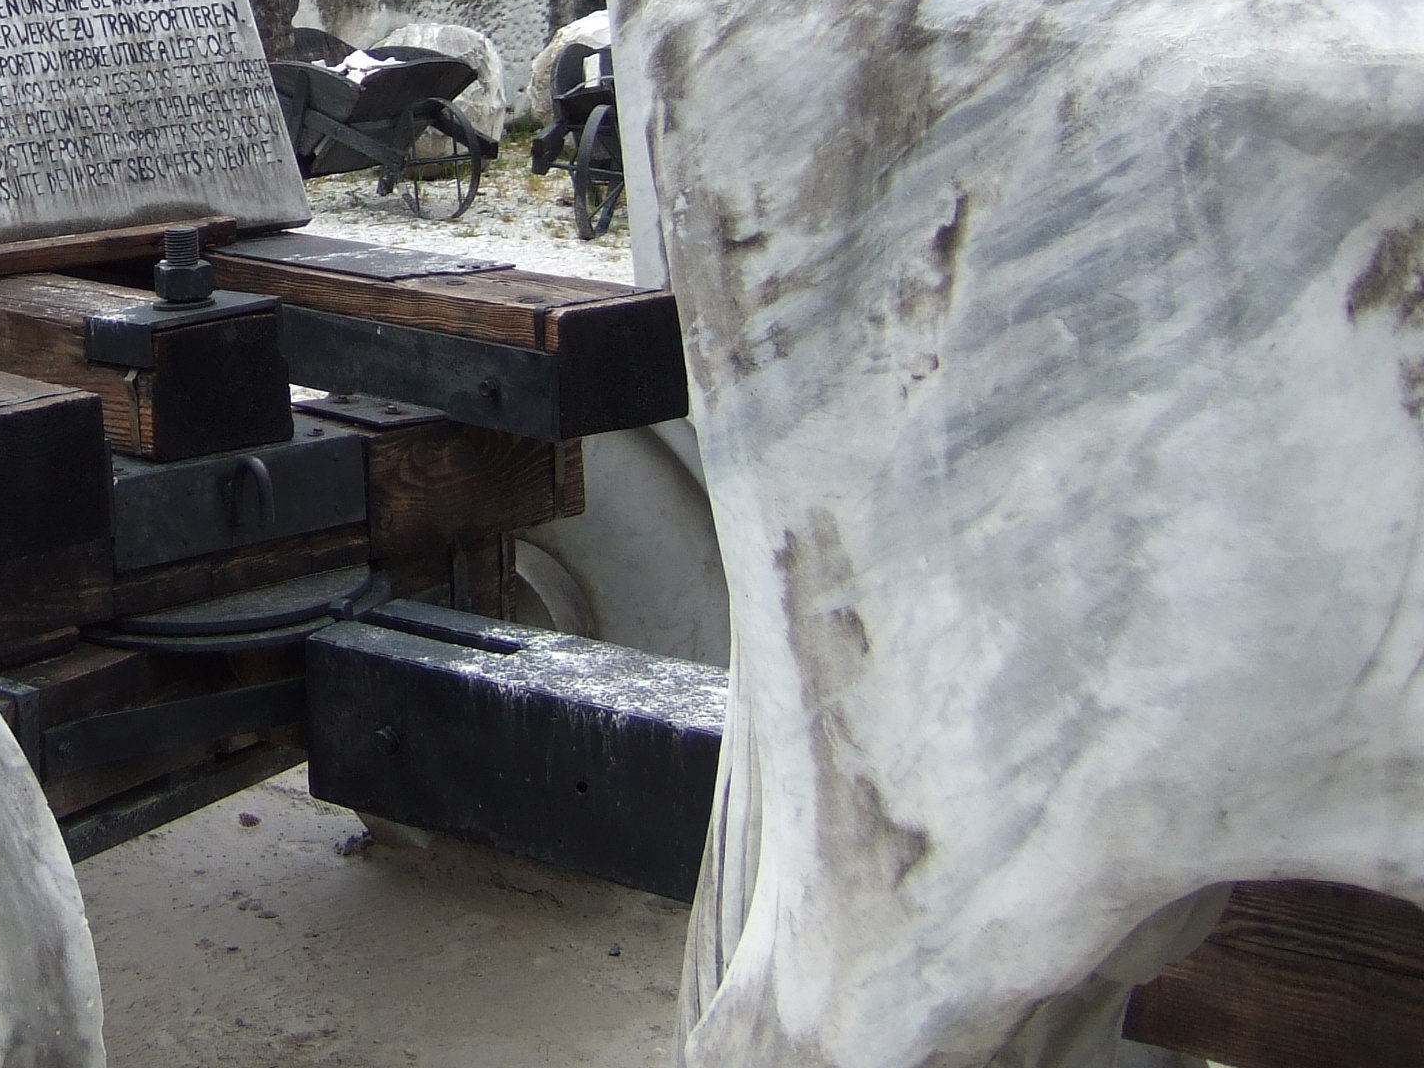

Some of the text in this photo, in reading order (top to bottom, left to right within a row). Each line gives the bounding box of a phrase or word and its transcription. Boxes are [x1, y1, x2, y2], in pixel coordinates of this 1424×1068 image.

[69, 17, 94, 40] ZU
[55, 107, 75, 132] UN
[58, 136, 97, 160] POUR
[128, 157, 155, 181] SES
[156, 151, 202, 178] CHEFS
